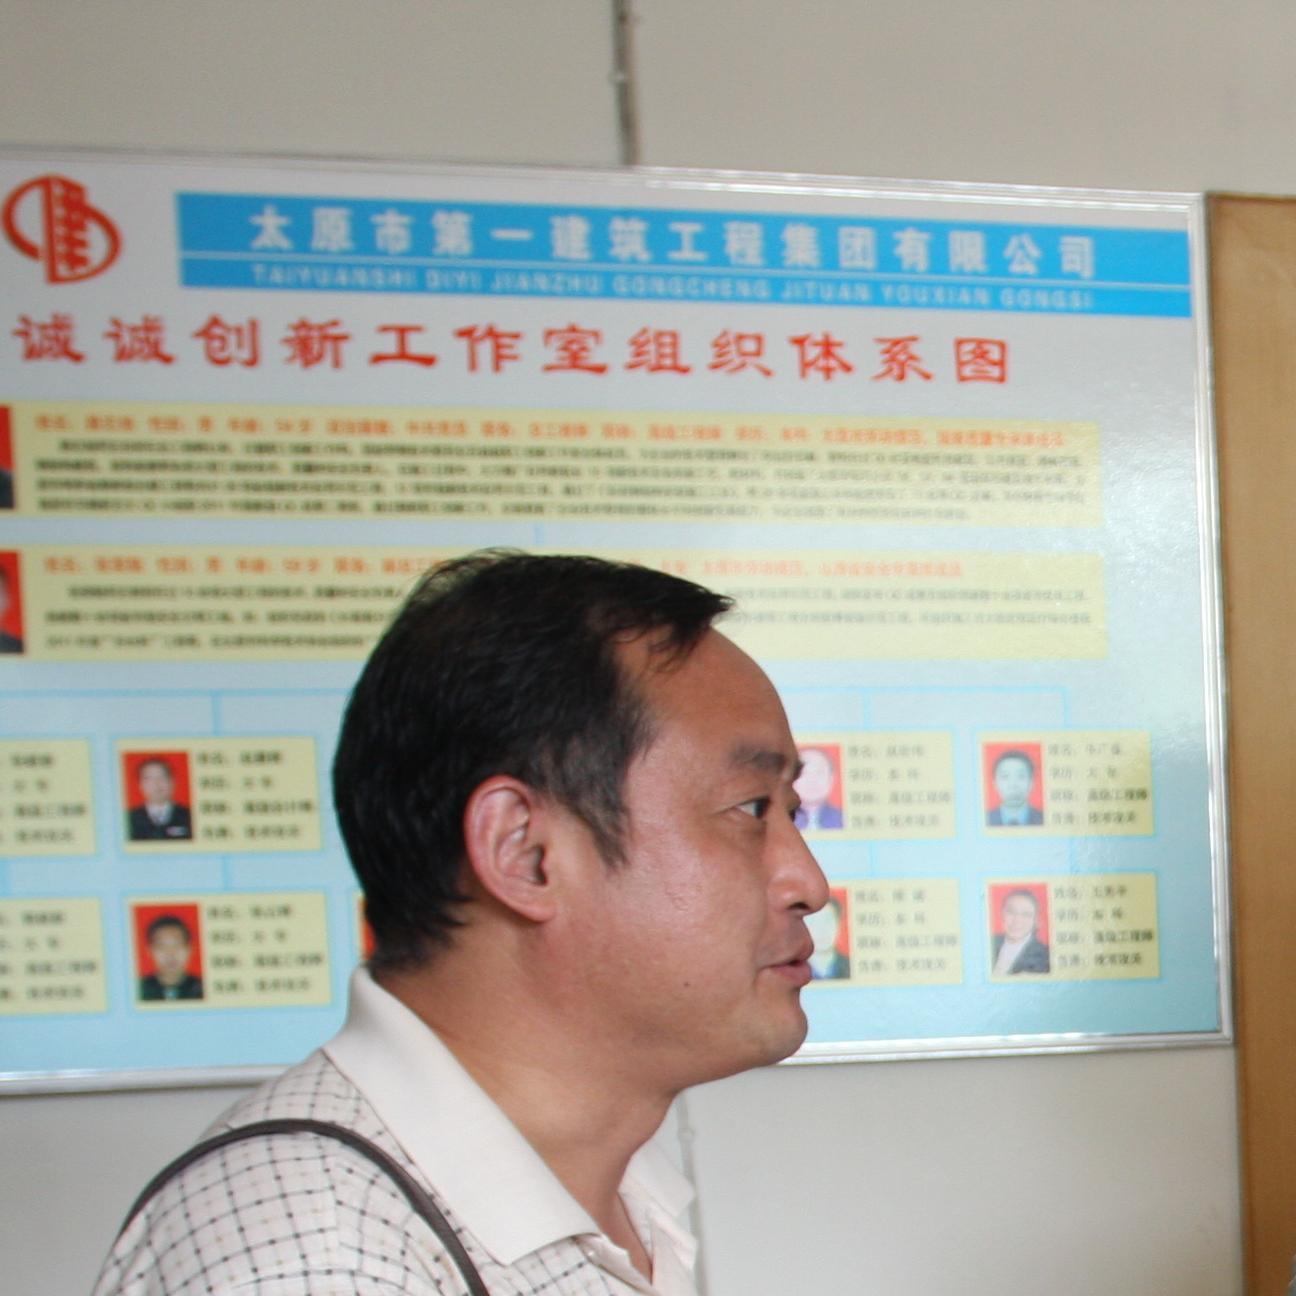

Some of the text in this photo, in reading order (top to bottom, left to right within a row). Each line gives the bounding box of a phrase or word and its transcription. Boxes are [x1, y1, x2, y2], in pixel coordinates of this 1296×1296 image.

[250, 204, 1096, 280] 太原市第一建筑工程集团有限公司
[253, 263, 1092, 310] TAIYUANSHI DIYI JIANZHU GONGCHENG JITUAN YOUXIAN GONGSI
